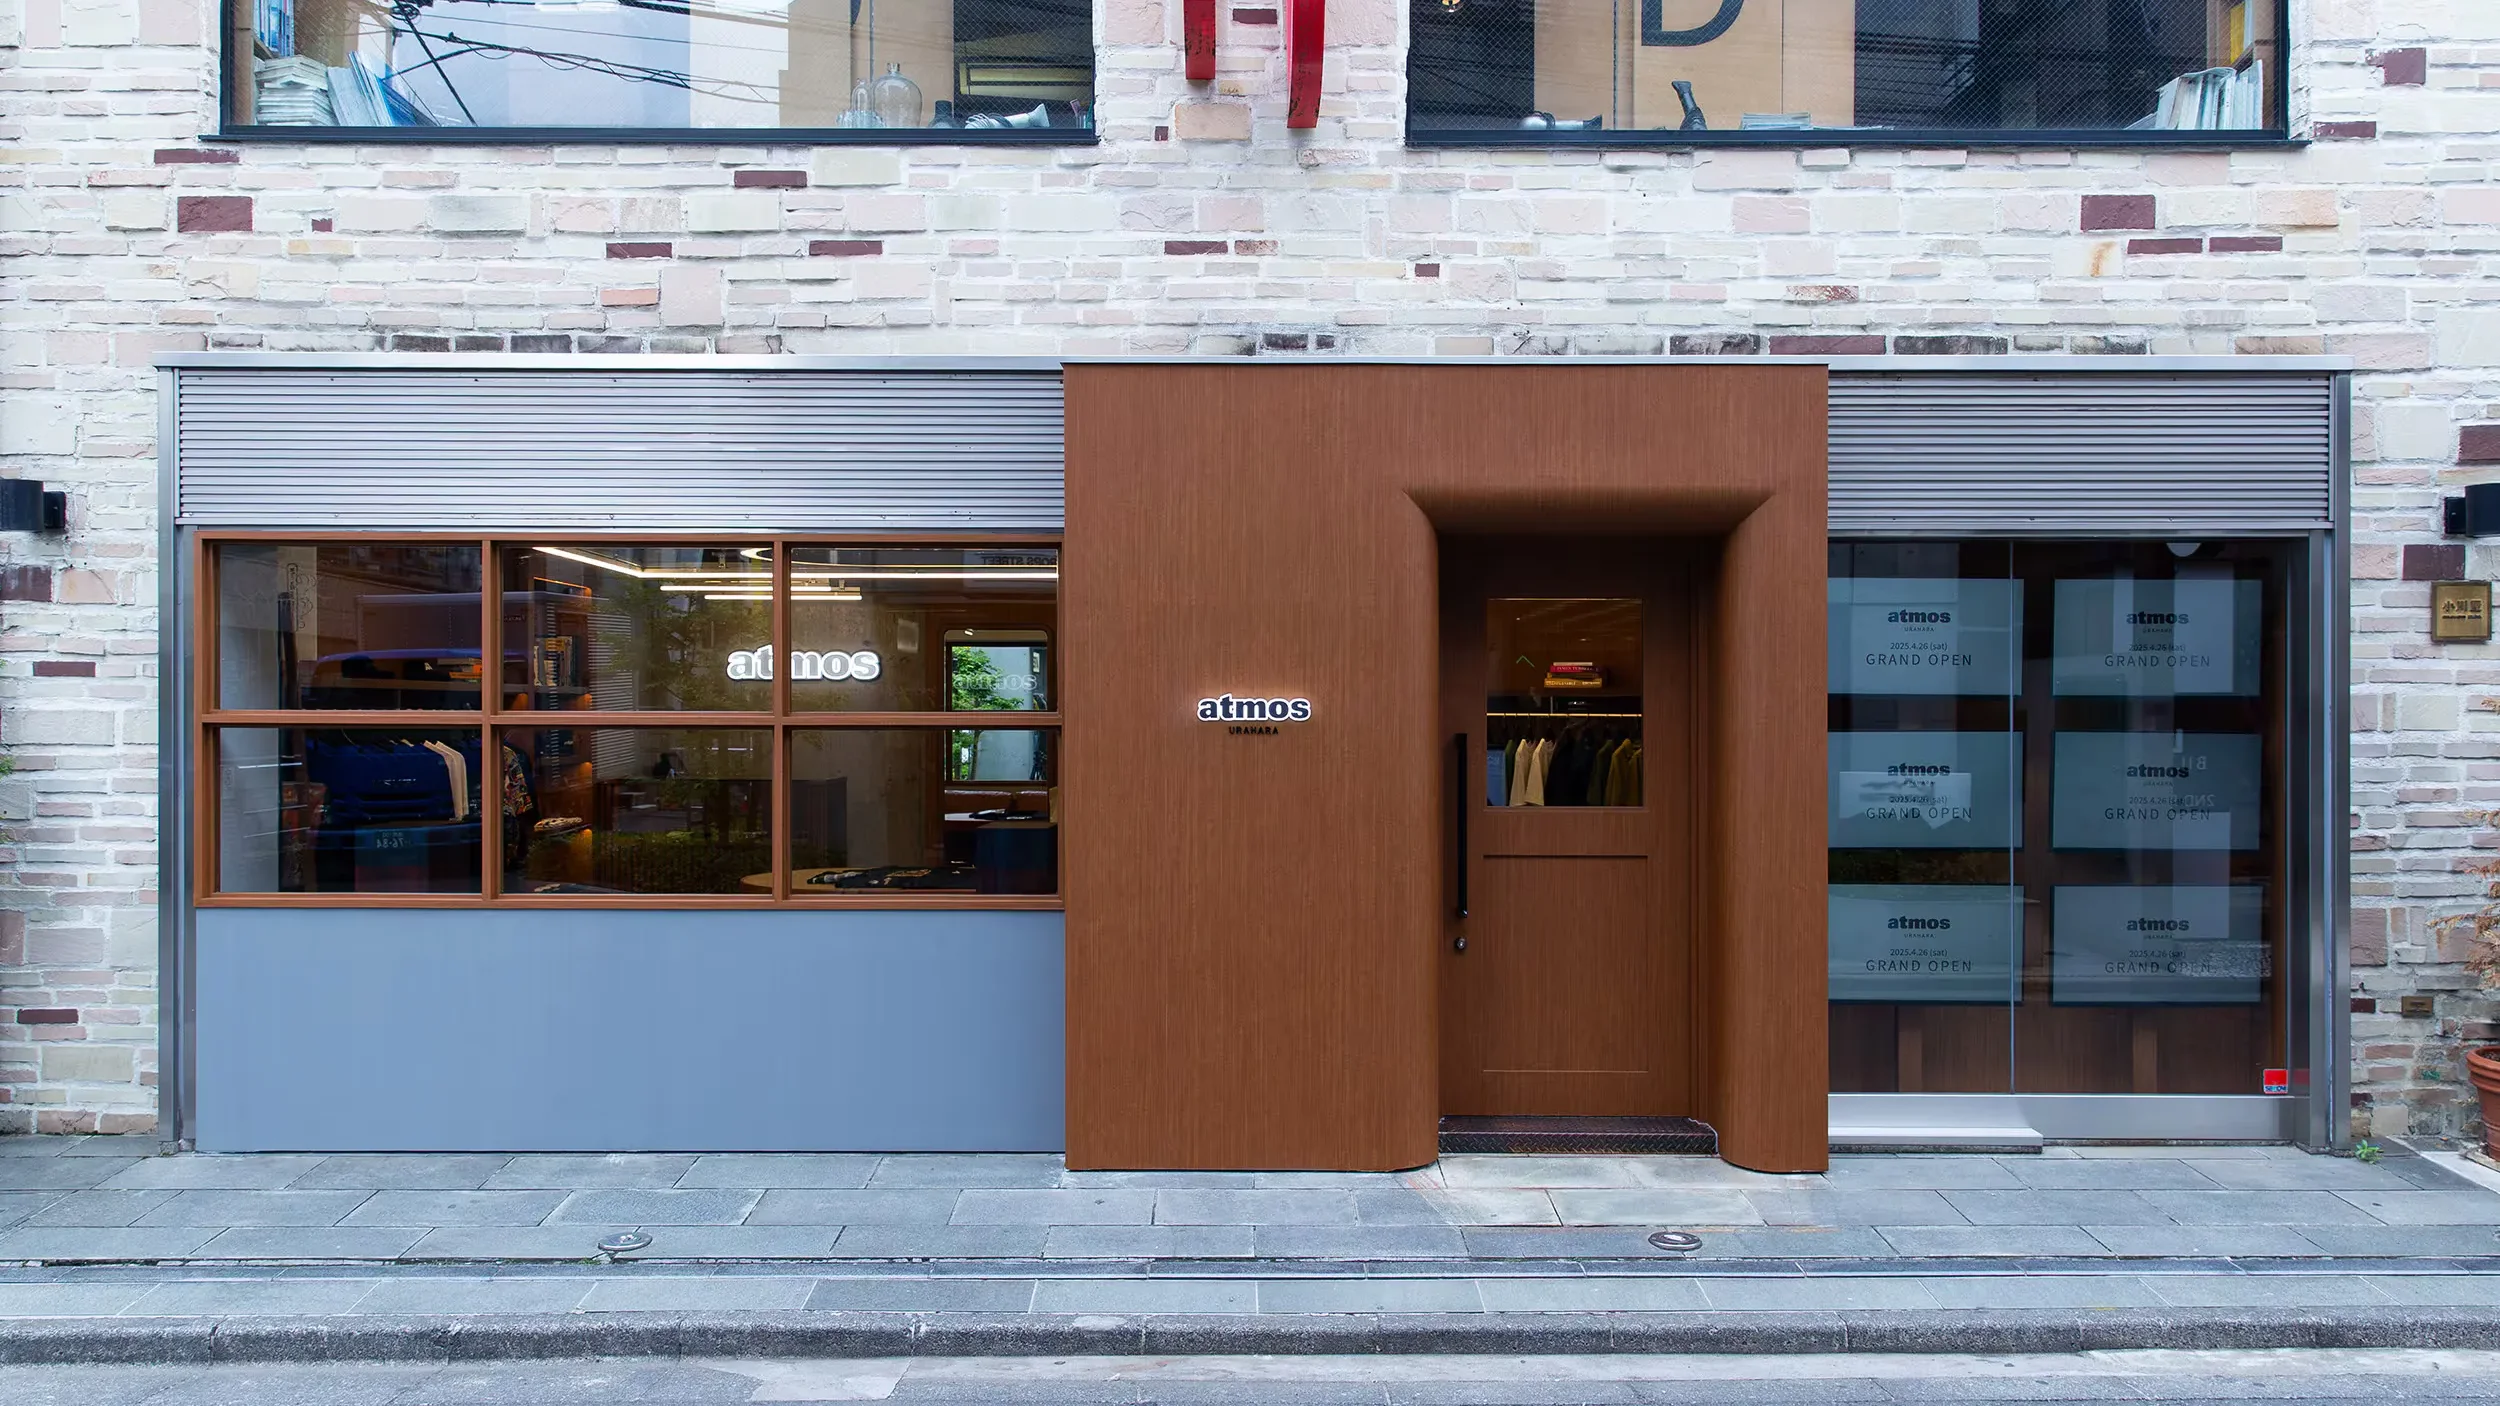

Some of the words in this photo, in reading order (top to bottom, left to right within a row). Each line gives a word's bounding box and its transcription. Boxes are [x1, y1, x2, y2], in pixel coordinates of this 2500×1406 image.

[1888, 609, 1951, 623] atmos
[2126, 611, 2189, 625] atmos
[1890, 642, 1928, 650] 2025.4.26
[1930, 642, 1948, 651] (sat)
[727, 645, 880, 681] atmos
[1866, 653, 1921, 666] GRAND
[1928, 654, 1972, 666] OPEN
[2104, 655, 2160, 667] GRAND
[2167, 655, 2210, 667] OPEN
[1198, 693, 1311, 721] atmos
[1228, 726, 1279, 735] URAHARA
[1888, 762, 1951, 776] atmos
[2126, 763, 2189, 778] atmos
[1866, 807, 1921, 819] GRAND
[1928, 807, 1972, 819] OPEN
[2104, 808, 2160, 820] GRAND
[2167, 809, 2210, 820] OPEN
[1888, 915, 1951, 929] atmos
[2126, 917, 2189, 931] atmos
[1930, 949, 1948, 957] (sat)
[2129, 950, 2167, 958] 2025.4.26
[1866, 960, 1921, 971] GRAND
[1928, 960, 1972, 971] OPEN
[2105, 962, 2160, 973] GRAND
